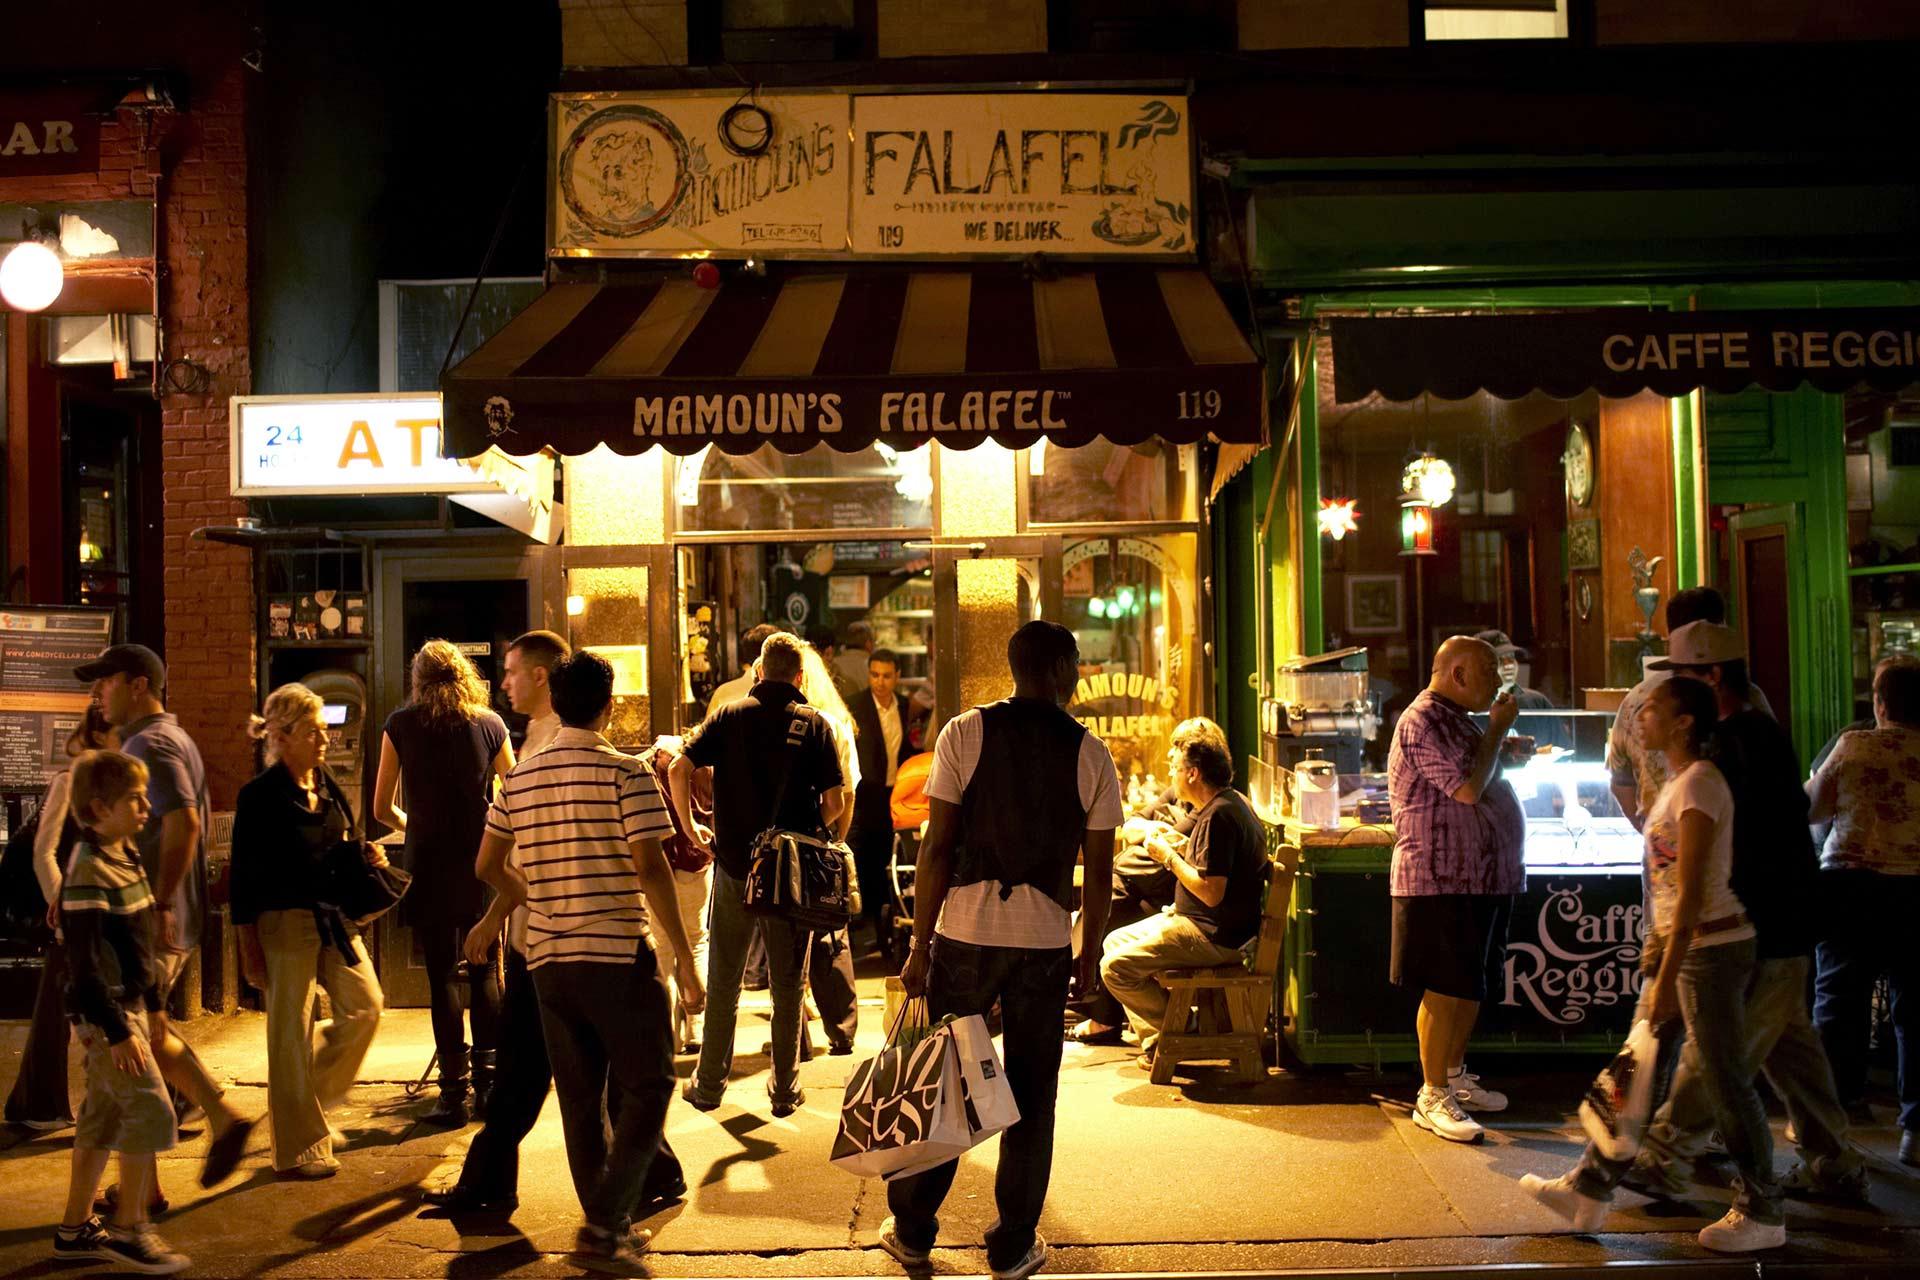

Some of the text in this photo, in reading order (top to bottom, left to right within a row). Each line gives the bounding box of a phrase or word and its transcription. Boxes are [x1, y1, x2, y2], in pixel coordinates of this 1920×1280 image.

[0, 121, 79, 155] AR
[864, 130, 1138, 196] FALAFEL
[878, 225, 904, 248] 119
[964, 221, 989, 242] WE
[1601, 330, 1920, 373] CAFFE REGGI
[632, 393, 843, 437] MAMOUN'S
[1176, 388, 1222, 420] 119
[265, 425, 304, 447] 24
[336, 417, 444, 470] AT
[1537, 882, 1643, 963] Caff
